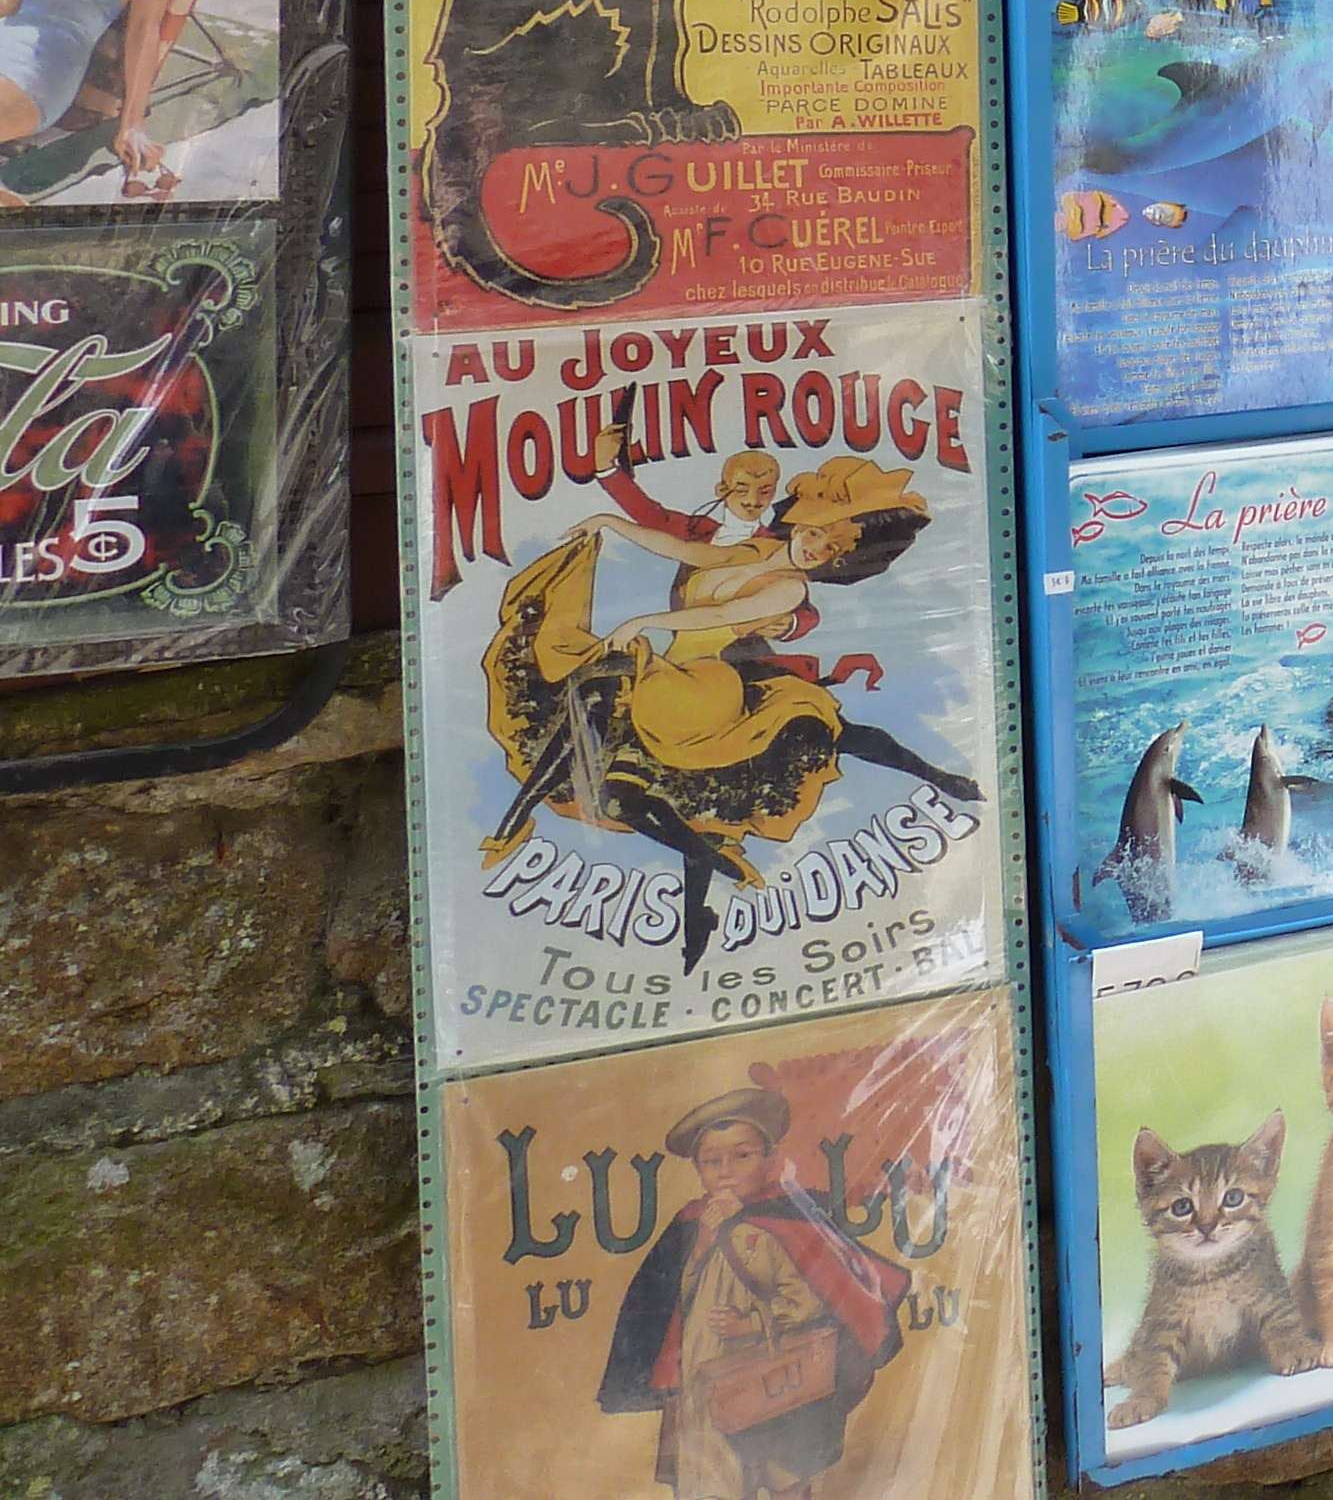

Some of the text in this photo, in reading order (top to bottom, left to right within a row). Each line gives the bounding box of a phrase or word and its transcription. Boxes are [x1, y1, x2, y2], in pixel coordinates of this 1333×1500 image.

[691, 21, 952, 59] DESSINS ORIGINAUX
[756, 58, 970, 81] Aquarelles TABLEAUX
[760, 79, 946, 98] Importante Composition
[747, 190, 776, 214] 34
[785, 188, 829, 208] RUE
[837, 187, 921, 205] BAUDIN
[738, 255, 765, 276] 10
[771, 255, 814, 277] RUE
[1086, 243, 1114, 273] La
[1122, 240, 1196, 279] prière
[1202, 233, 1236, 266] du
[445, 318, 836, 392] AU JOYEUX
[421, 366, 974, 604] MOULIN ROUGE
[1160, 471, 1227, 537] La
[1231, 486, 1328, 546] prière
[482, 835, 689, 950] PARIS
[793, 784, 983, 923] DANSE
[460, 927, 988, 1031] SPECTACLE CONCERT BAL
[540, 907, 937, 997] Tous les Soirs
[496, 1125, 957, 1267] LU LU
[524, 1277, 962, 1333] LU LU
